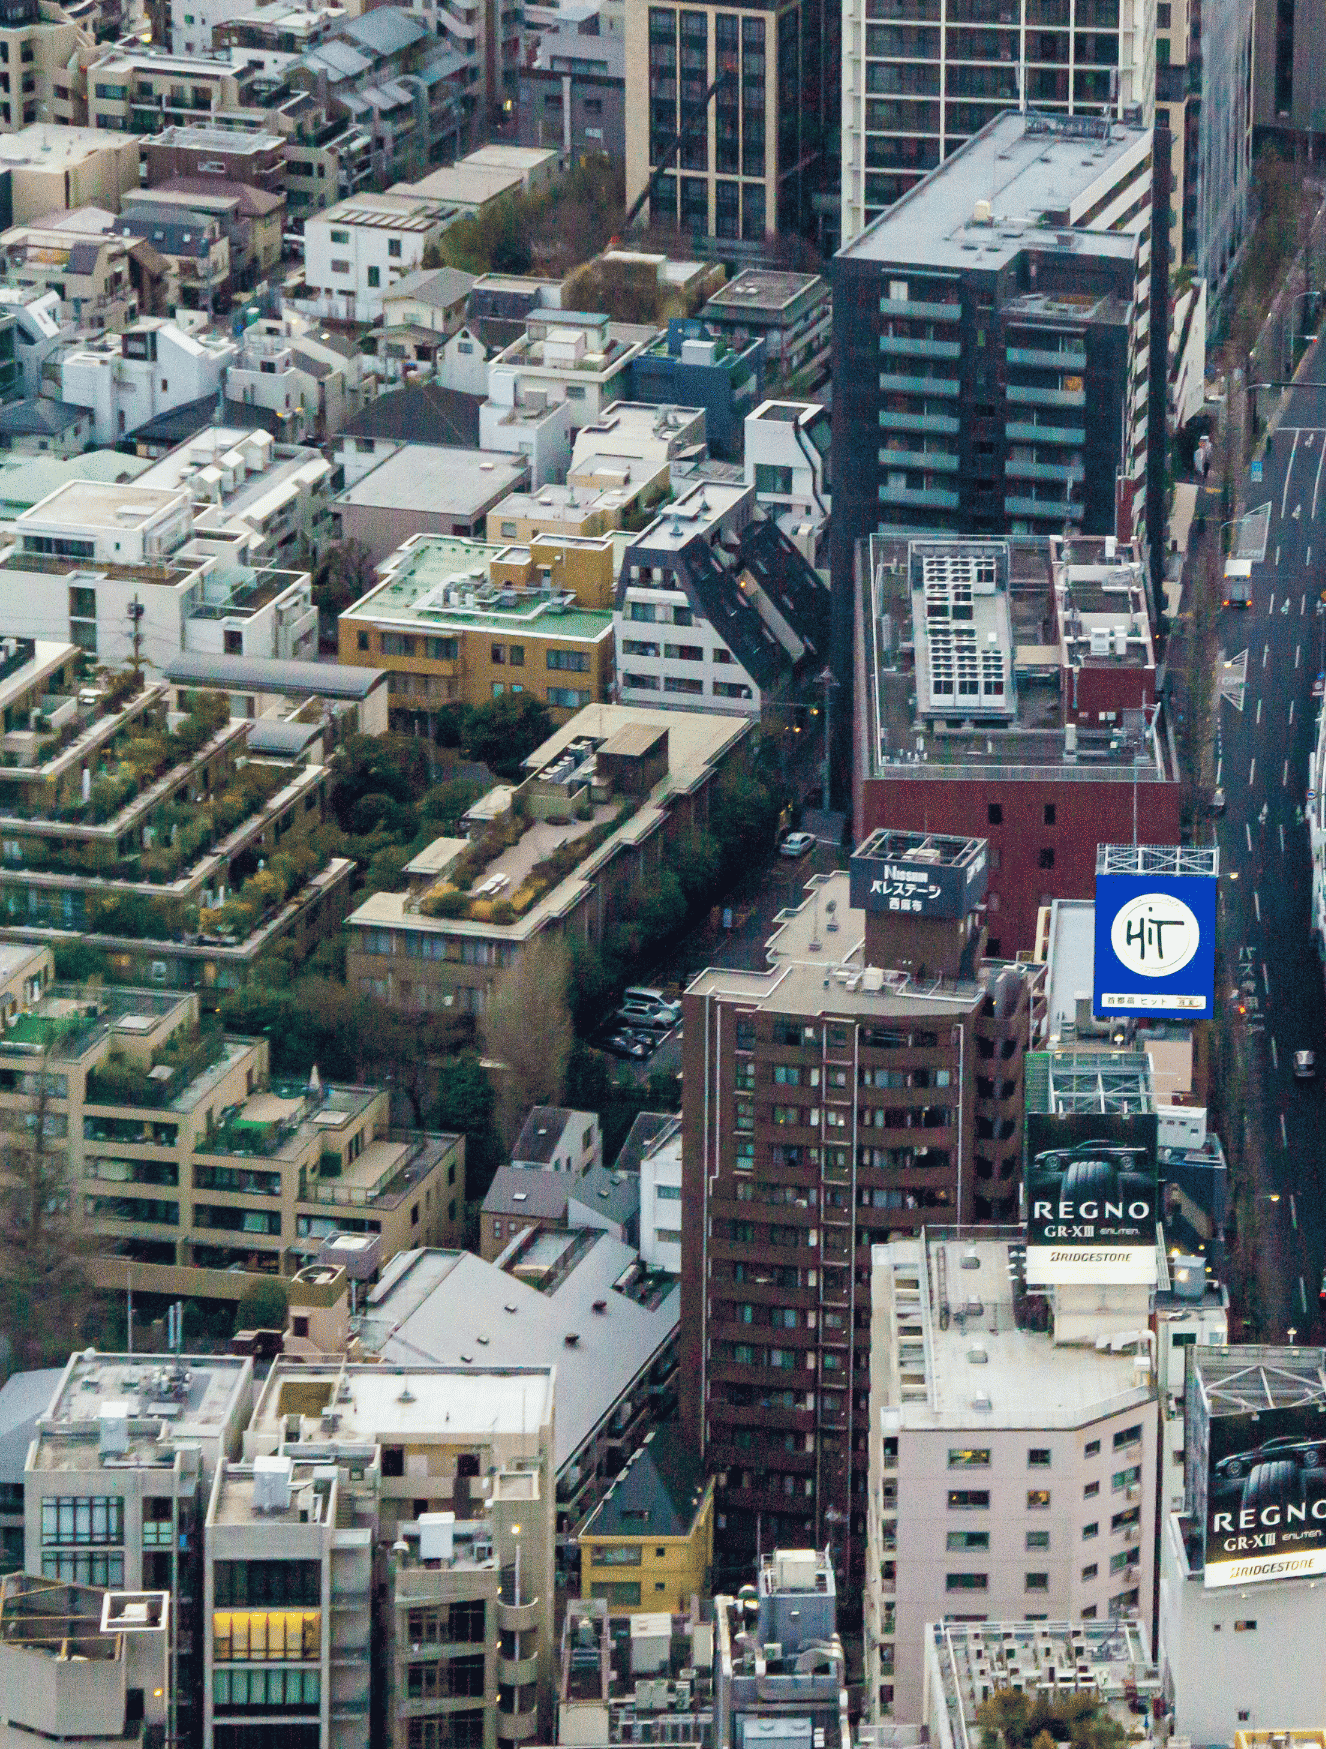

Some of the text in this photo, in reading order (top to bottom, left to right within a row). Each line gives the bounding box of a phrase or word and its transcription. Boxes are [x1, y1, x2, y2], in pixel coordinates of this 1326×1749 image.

[1033, 1201, 1150, 1219] REGNO
[1050, 1252, 1133, 1262] BRIDGESTONE
[1229, 1558, 1316, 1579] BRIDGESTONE
